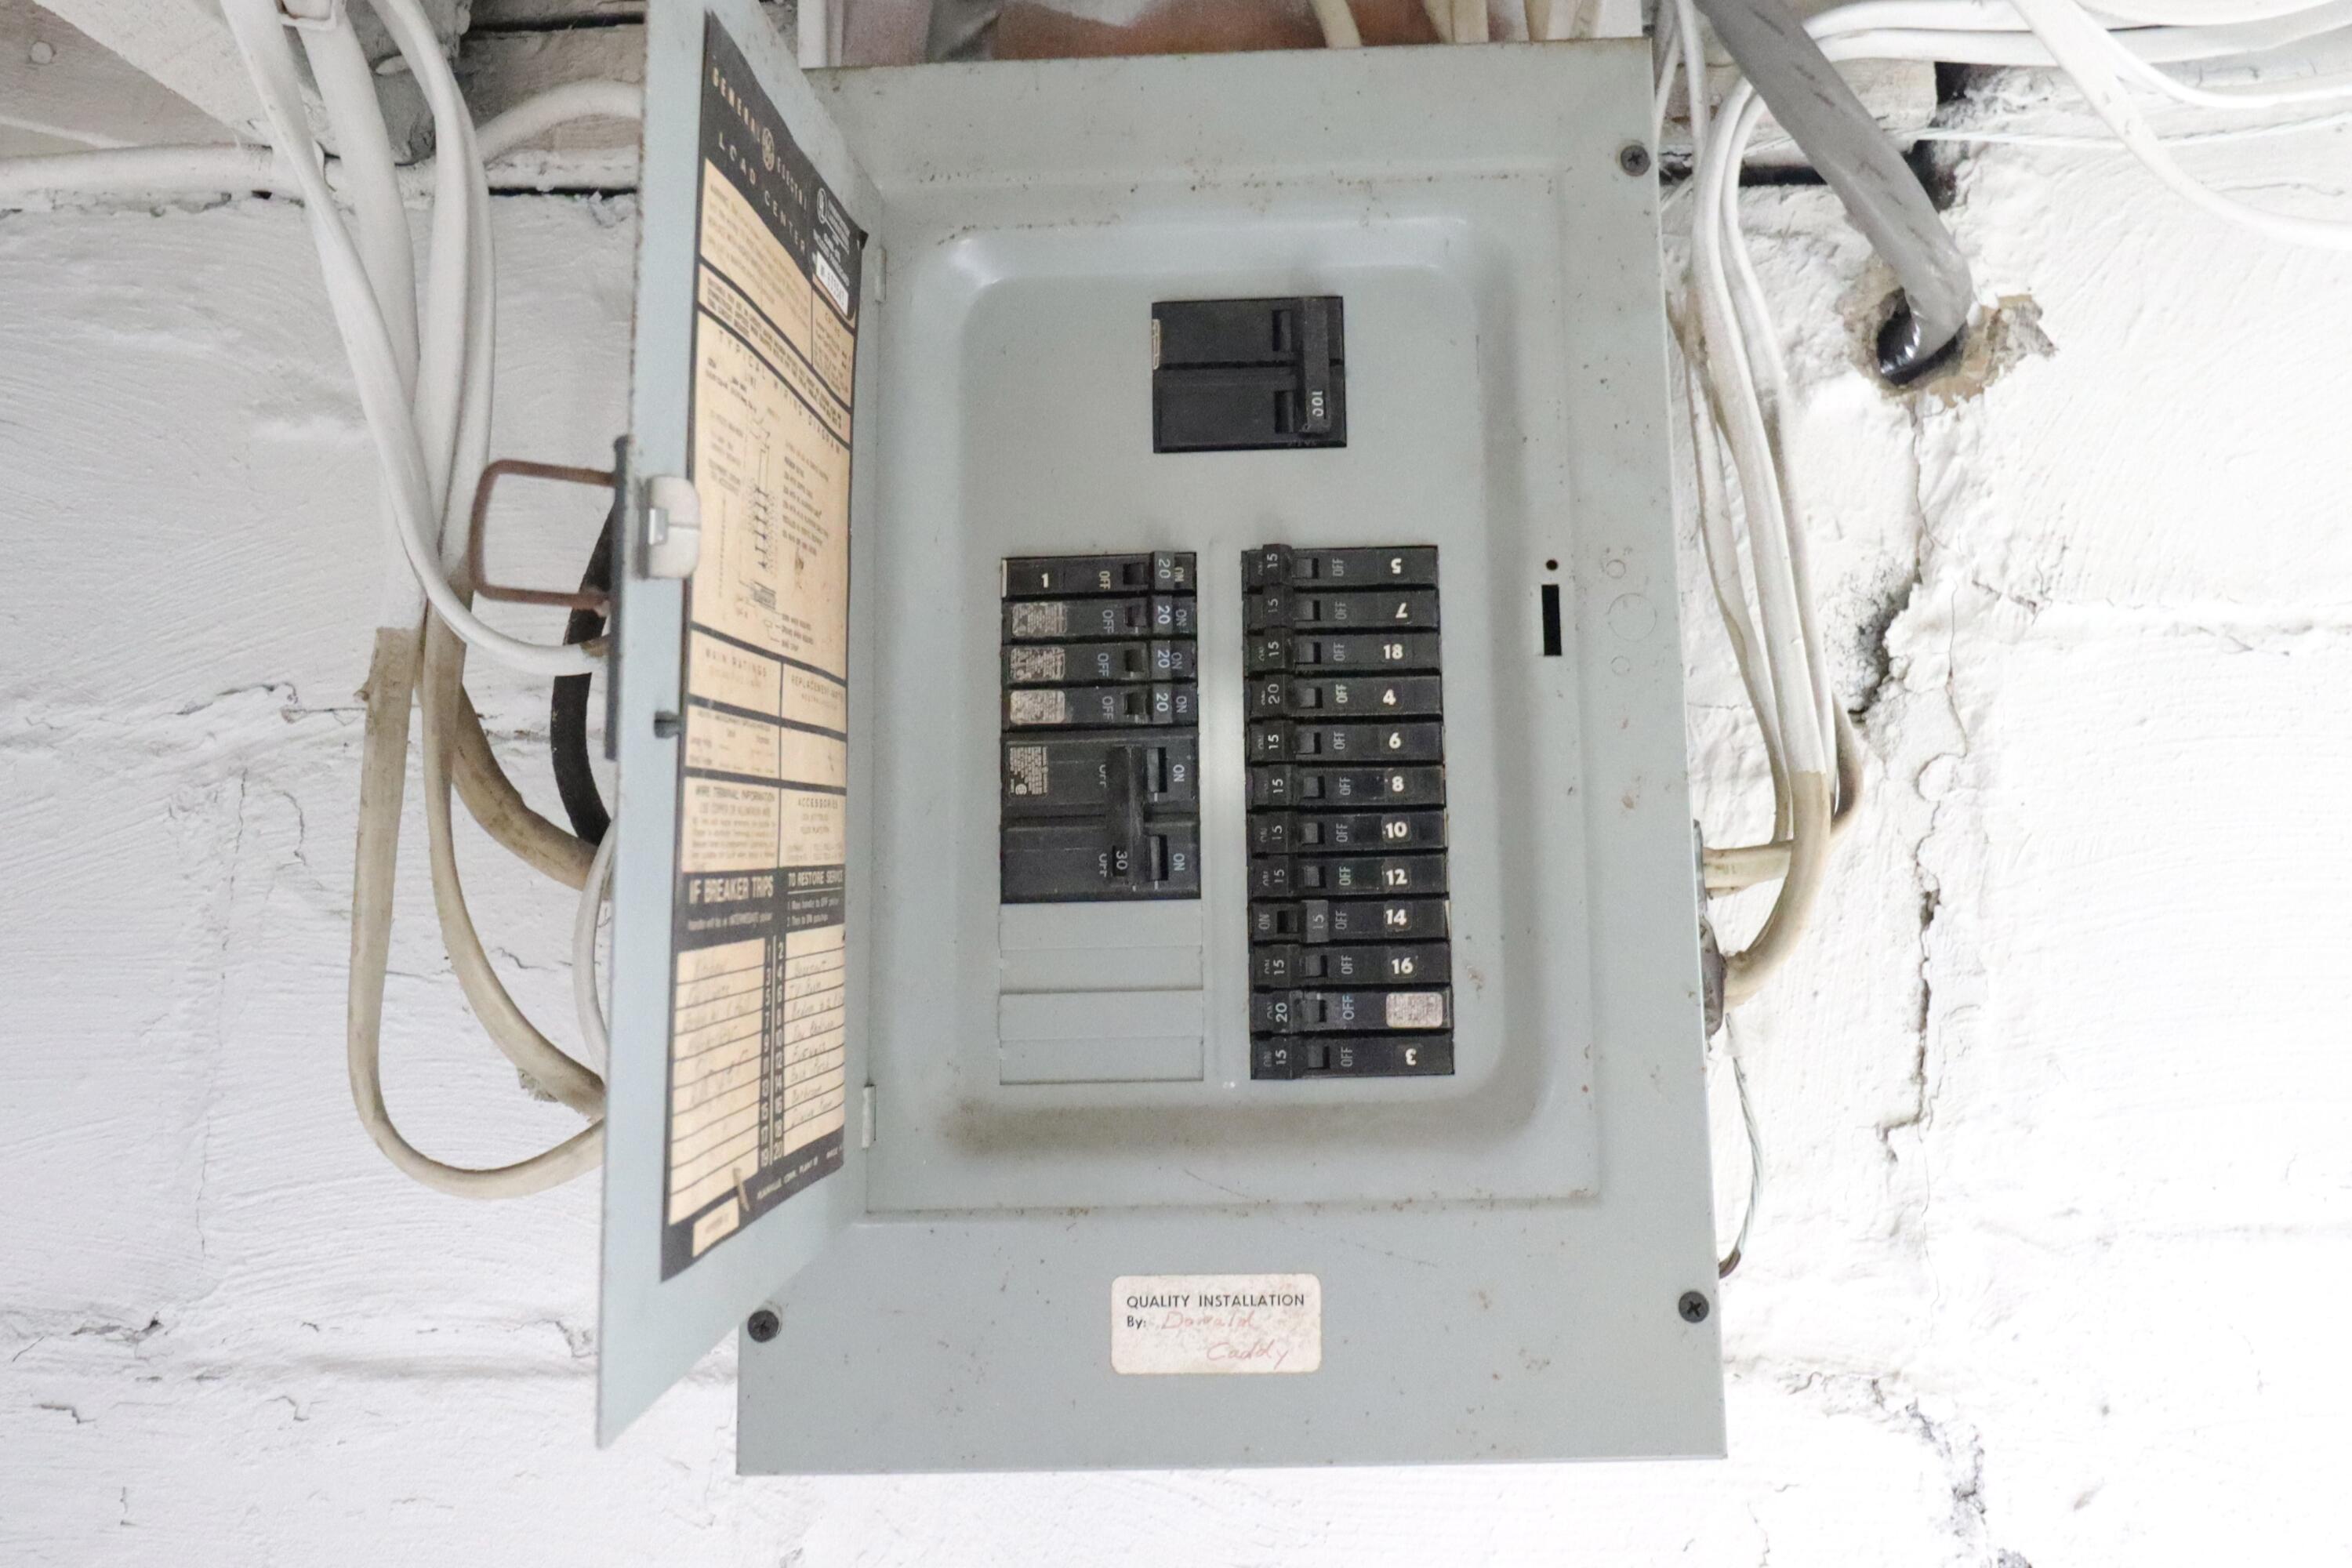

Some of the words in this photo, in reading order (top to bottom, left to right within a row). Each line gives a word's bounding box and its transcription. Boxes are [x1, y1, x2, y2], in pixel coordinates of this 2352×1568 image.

[712, 67, 760, 143] GENERAL
[718, 132, 757, 185] LOAD
[764, 191, 806, 252] CENTER
[1311, 390, 1324, 417] 100
[1041, 573, 1049, 588] 1
[1098, 570, 1110, 590] OFF
[1158, 558, 1171, 579] 20
[1267, 554, 1278, 569] 15
[1332, 557, 1345, 577] OFF
[1102, 609, 1114, 633] OFF
[1157, 604, 1171, 625] 20
[1175, 609, 1187, 626] ON
[1268, 598, 1279, 614] 15
[1335, 601, 1347, 620] OFF
[1395, 602, 1408, 619] 7
[1268, 641, 1279, 657] 15
[1334, 642, 1345, 662] OFF
[1383, 644, 1403, 659] 18
[1098, 652, 1109, 677] OFF
[1157, 649, 1170, 668] 20
[1171, 652, 1182, 670] ON
[1268, 683, 1280, 705] 20
[1335, 684, 1348, 703] OFF
[1382, 688, 1397, 706] 4
[1102, 695, 1114, 720] OFF
[1156, 692, 1169, 712] 20
[1175, 695, 1187, 713] ON
[1268, 734, 1279, 750] 15
[1333, 731, 1346, 750] OFF
[1388, 731, 1402, 750] 6
[1173, 764, 1185, 782] ON
[1272, 778, 1284, 794] 15
[1339, 776, 1352, 796] OFF
[1392, 775, 1405, 793] 8
[1272, 825, 1283, 840] 15
[1336, 823, 1348, 843] OFF
[1385, 822, 1408, 839] 10
[1116, 850, 1128, 870] 30
[1173, 852, 1185, 871] ON
[787, 873, 797, 888] TO
[797, 871, 825, 886] RESTORE
[1273, 869, 1285, 884] 15
[1339, 866, 1352, 886] OFF
[1386, 869, 1408, 886] 12
[688, 879, 702, 905] IF
[703, 876, 750, 904] BREAKER
[752, 875, 774, 898] TRIPS
[1258, 913, 1271, 930] ON
[1312, 913, 1324, 930] 15
[1335, 910, 1348, 930] OFF
[1385, 909, 1407, 926] 14
[778, 942, 784, 960] 2
[1272, 959, 1285, 975] 15
[1341, 955, 1353, 975] OFF
[1392, 957, 1414, 975] 16
[1276, 1002, 1288, 1023] 20
[1342, 993, 1355, 1020] OFF
[1276, 1049, 1287, 1065] 15
[1341, 1047, 1353, 1067] OFF
[1405, 1048, 1417, 1065] 3
[1126, 1295, 1190, 1308] QUALITY
[1199, 1294, 1305, 1308] INSTALLATION
[1127, 1315, 1147, 1329] By:
